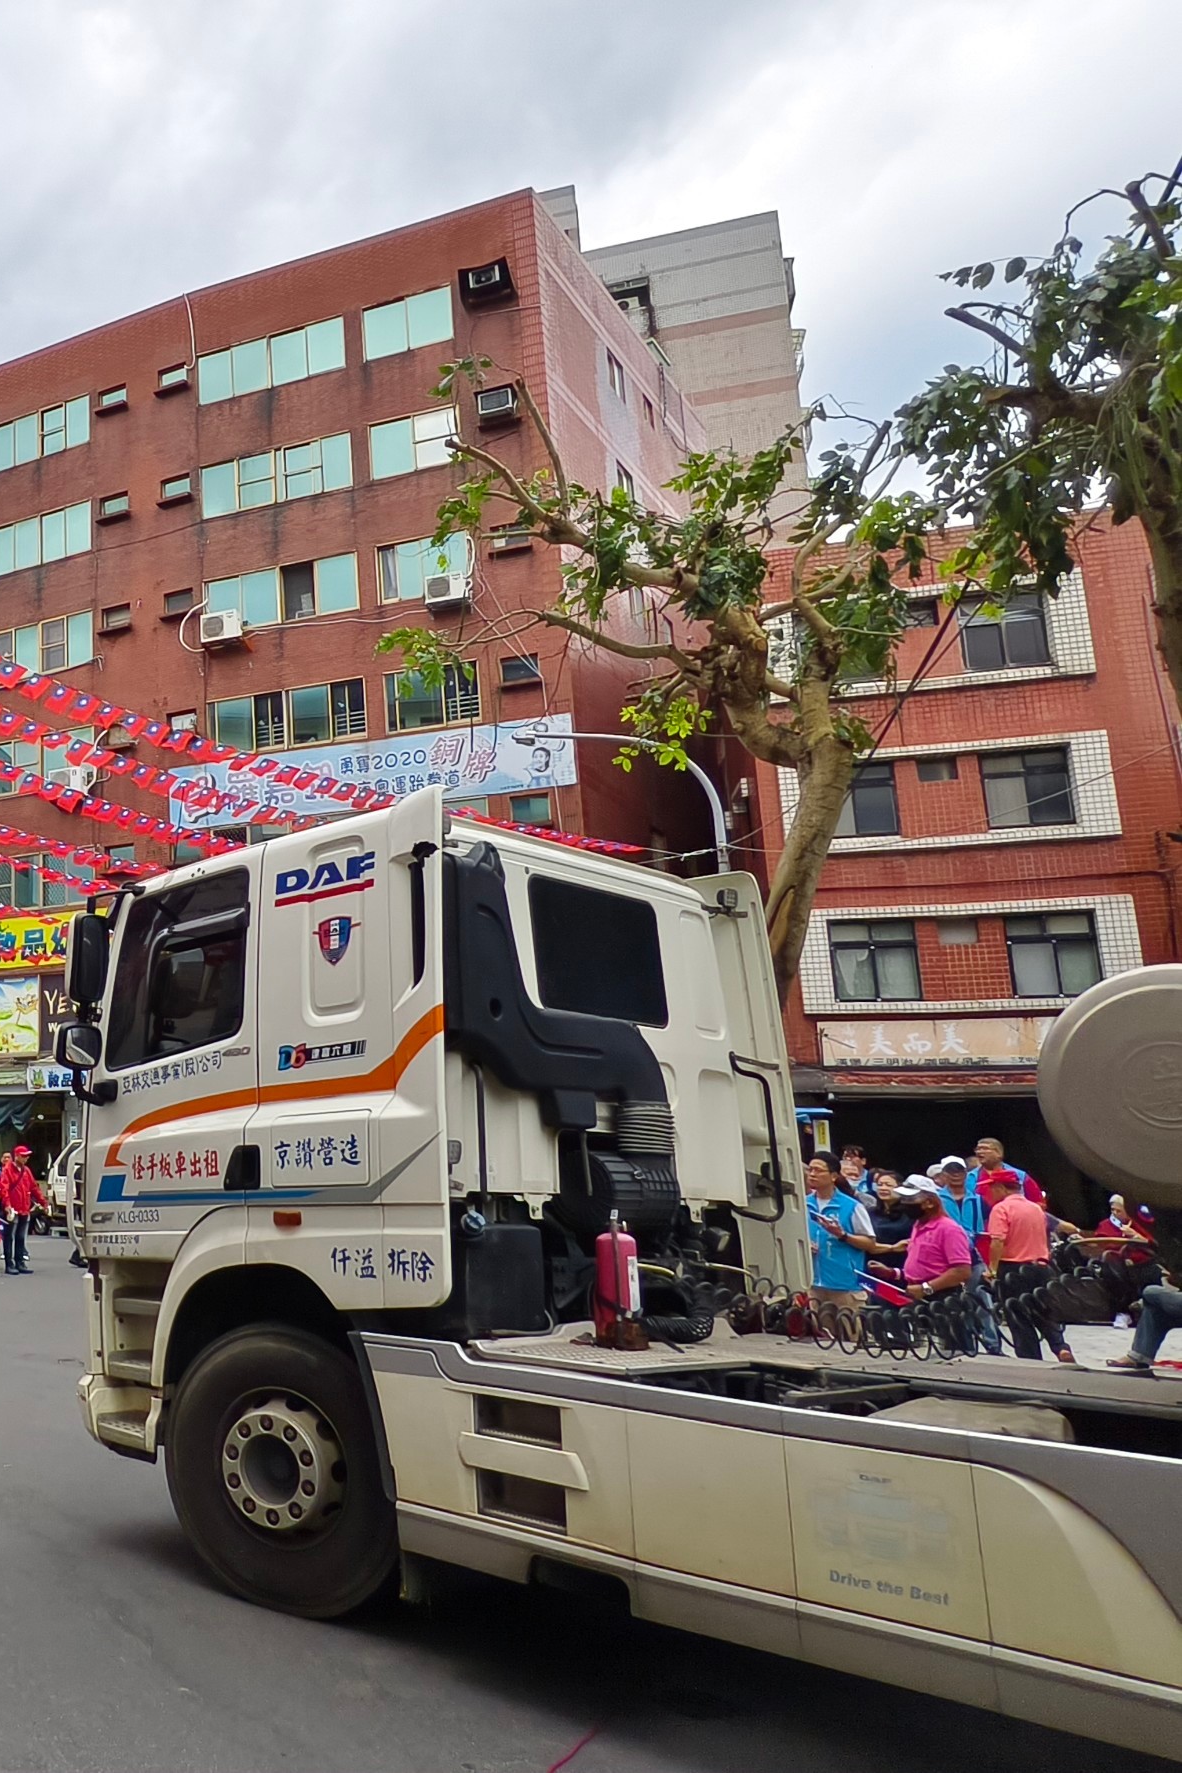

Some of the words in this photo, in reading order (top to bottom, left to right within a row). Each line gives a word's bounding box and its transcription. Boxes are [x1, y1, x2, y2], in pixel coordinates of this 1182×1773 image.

[275, 851, 375, 895] DAF
[131, 1149, 219, 1180] 怪手板車出租
[117, 1209, 159, 1224] KLG-0333
[387, 1248, 435, 1283] 拆除
[829, 1569, 871, 1590] Drive
[876, 1581, 904, 1596] the
[910, 1585, 949, 1606] Best
